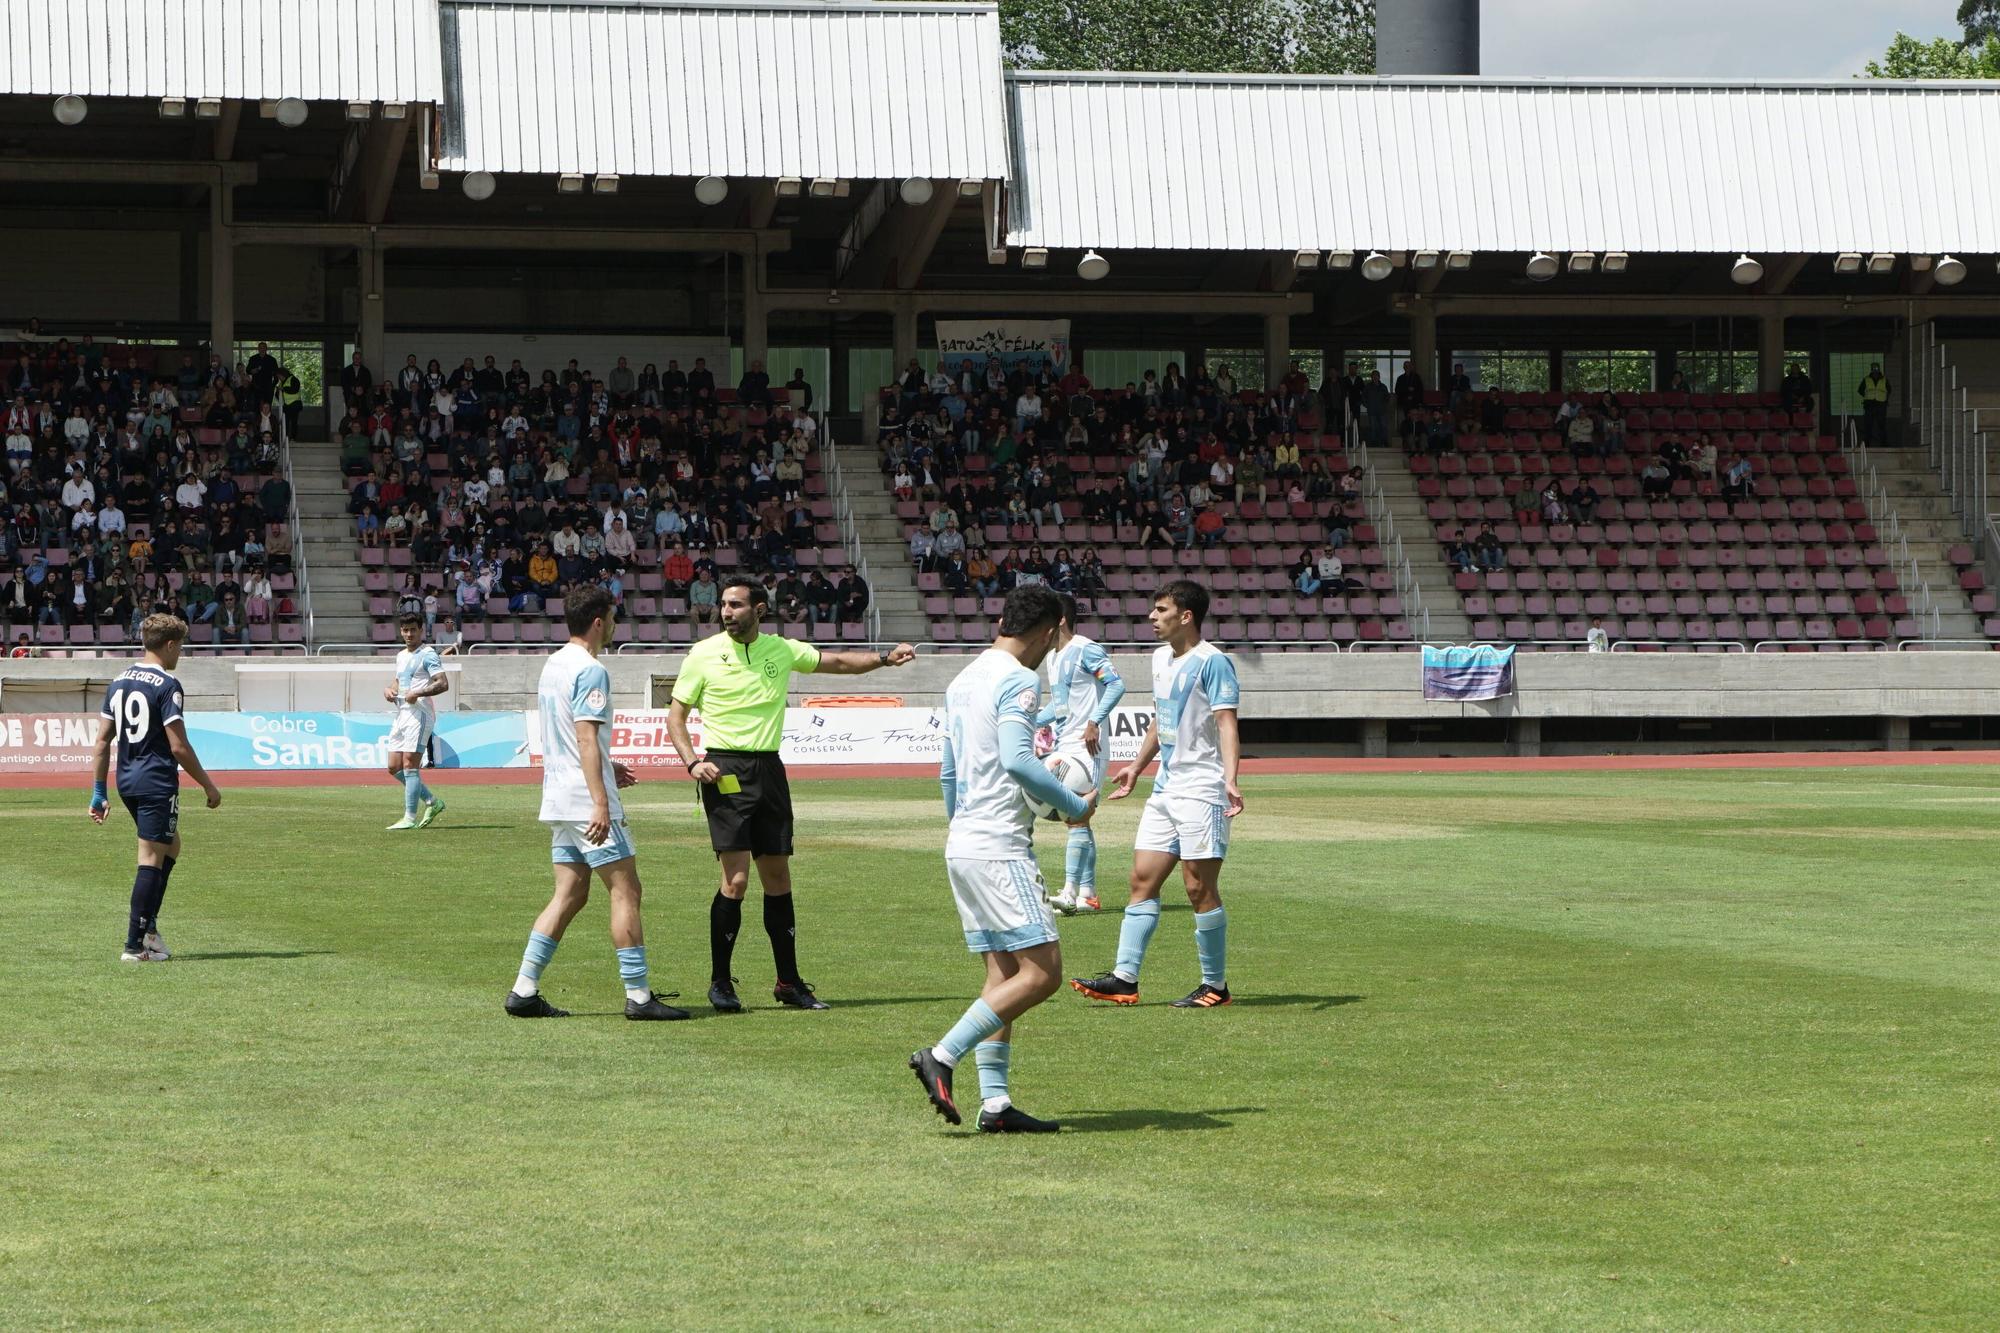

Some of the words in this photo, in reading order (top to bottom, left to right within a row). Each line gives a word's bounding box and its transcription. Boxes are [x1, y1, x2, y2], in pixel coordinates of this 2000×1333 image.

[136, 672, 164, 686] CUETO
[110, 689, 150, 743] 19
[251, 715, 317, 733] Cobre
[793, 744, 854, 754] CONSERVAS
[908, 744, 943, 753] CONSE
[1112, 750, 1138, 758] TIAGO
[0, 753, 41, 764] antiago
[44, 753, 58, 762] de
